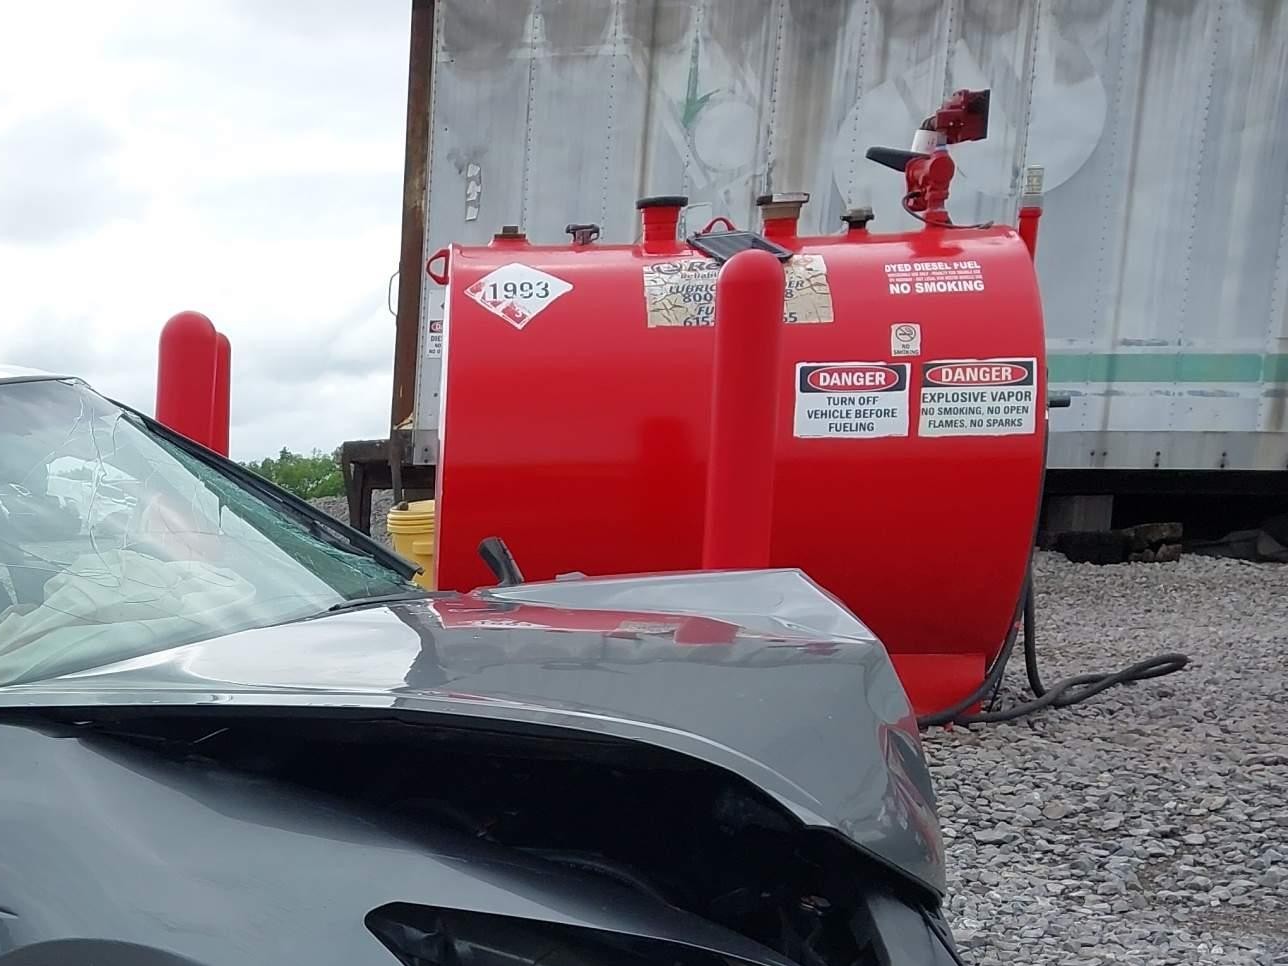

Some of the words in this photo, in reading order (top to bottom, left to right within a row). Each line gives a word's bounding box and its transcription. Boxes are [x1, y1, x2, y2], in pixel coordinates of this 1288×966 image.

[687, 261, 720, 272] Re
[884, 263, 912, 273] DYED
[913, 262, 952, 272] DIESEL
[953, 260, 981, 270] FUEL
[489, 281, 550, 300] 1993
[669, 284, 717, 295] LUBRIC
[889, 283, 911, 295] NO
[914, 280, 985, 294] SMOKING
[682, 292, 714, 303] 800
[697, 306, 715, 316] FU
[819, 371, 886, 386] DANGER
[941, 366, 1012, 382] DANGER
[826, 396, 856, 406] TURN
[858, 396, 880, 406] OFF
[922, 391, 987, 403] EXPLOSIVE
[991, 390, 1032, 402] VAPOR
[807, 409, 852, 419] VEHICLE
[854, 408, 898, 418] BEFORE
[921, 407, 935, 416] NO
[937, 406, 985, 416] SMOKING,
[987, 406, 1001, 415] NO
[1003, 405, 1029, 415] OPEN
[828, 422, 875, 432] FUELING
[928, 419, 968, 429] FLAMES,
[969, 418, 984, 428] NO
[986, 418, 1023, 427] SPARKS
